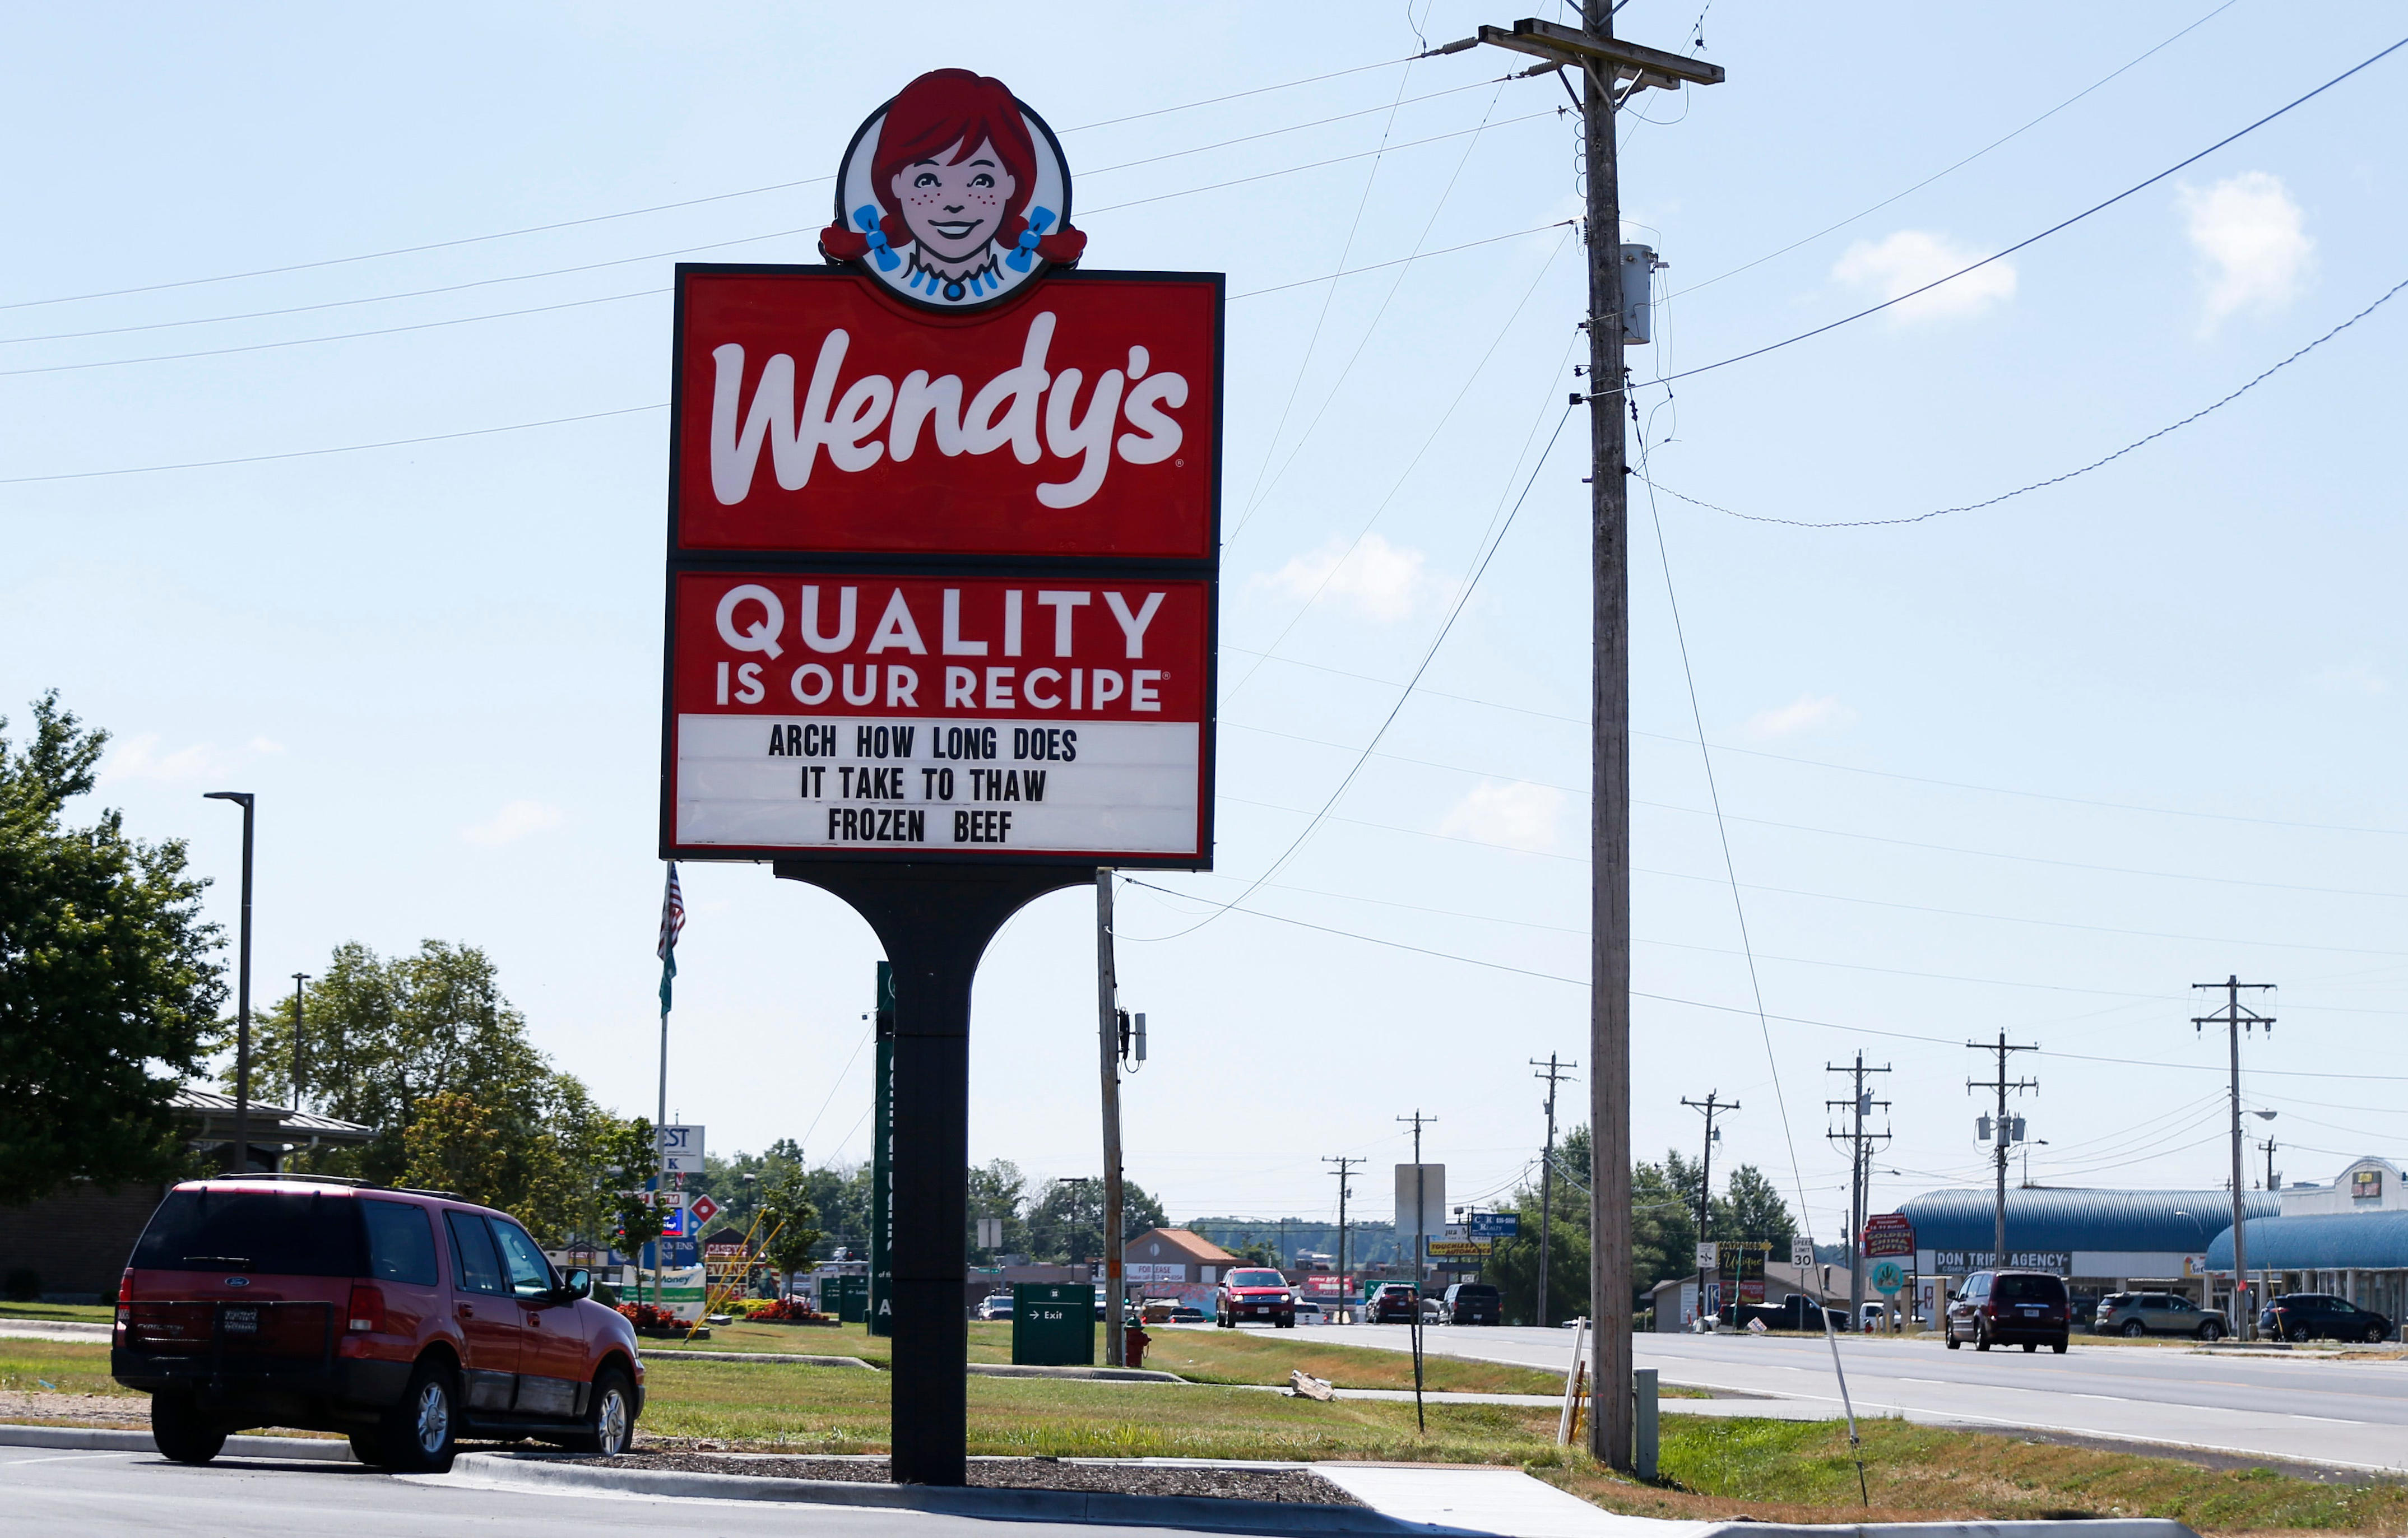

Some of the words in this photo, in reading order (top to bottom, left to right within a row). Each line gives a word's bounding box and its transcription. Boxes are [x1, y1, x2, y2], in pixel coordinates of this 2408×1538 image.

[711, 311, 1189, 509] Wendy's
[716, 584, 1166, 659] QUALITY
[717, 662, 765, 705] IS
[791, 663, 919, 708] OUR
[945, 666, 1161, 712] RECIPE
[769, 724, 836, 758] ARCH
[857, 726, 915, 759] HOW
[933, 727, 996, 760] LONG
[1014, 728, 1077, 762] DOES
[801, 766, 825, 798] IT
[839, 767, 903, 800] TAKE
[922, 768, 954, 801] TO
[970, 769, 1046, 802] THAW
[829, 808, 925, 842] FROZEN
[954, 810, 1012, 843] BEEF
[1794, 1255, 1811, 1266] 30
[1870, 1244, 1910, 1254] BUFFET
[1937, 1253, 1964, 1265] DON
[1968, 1253, 2005, 1265] TRIP
[2010, 1253, 2064, 1266] AGENCY
[1044, 1311, 1063, 1319] Exit
